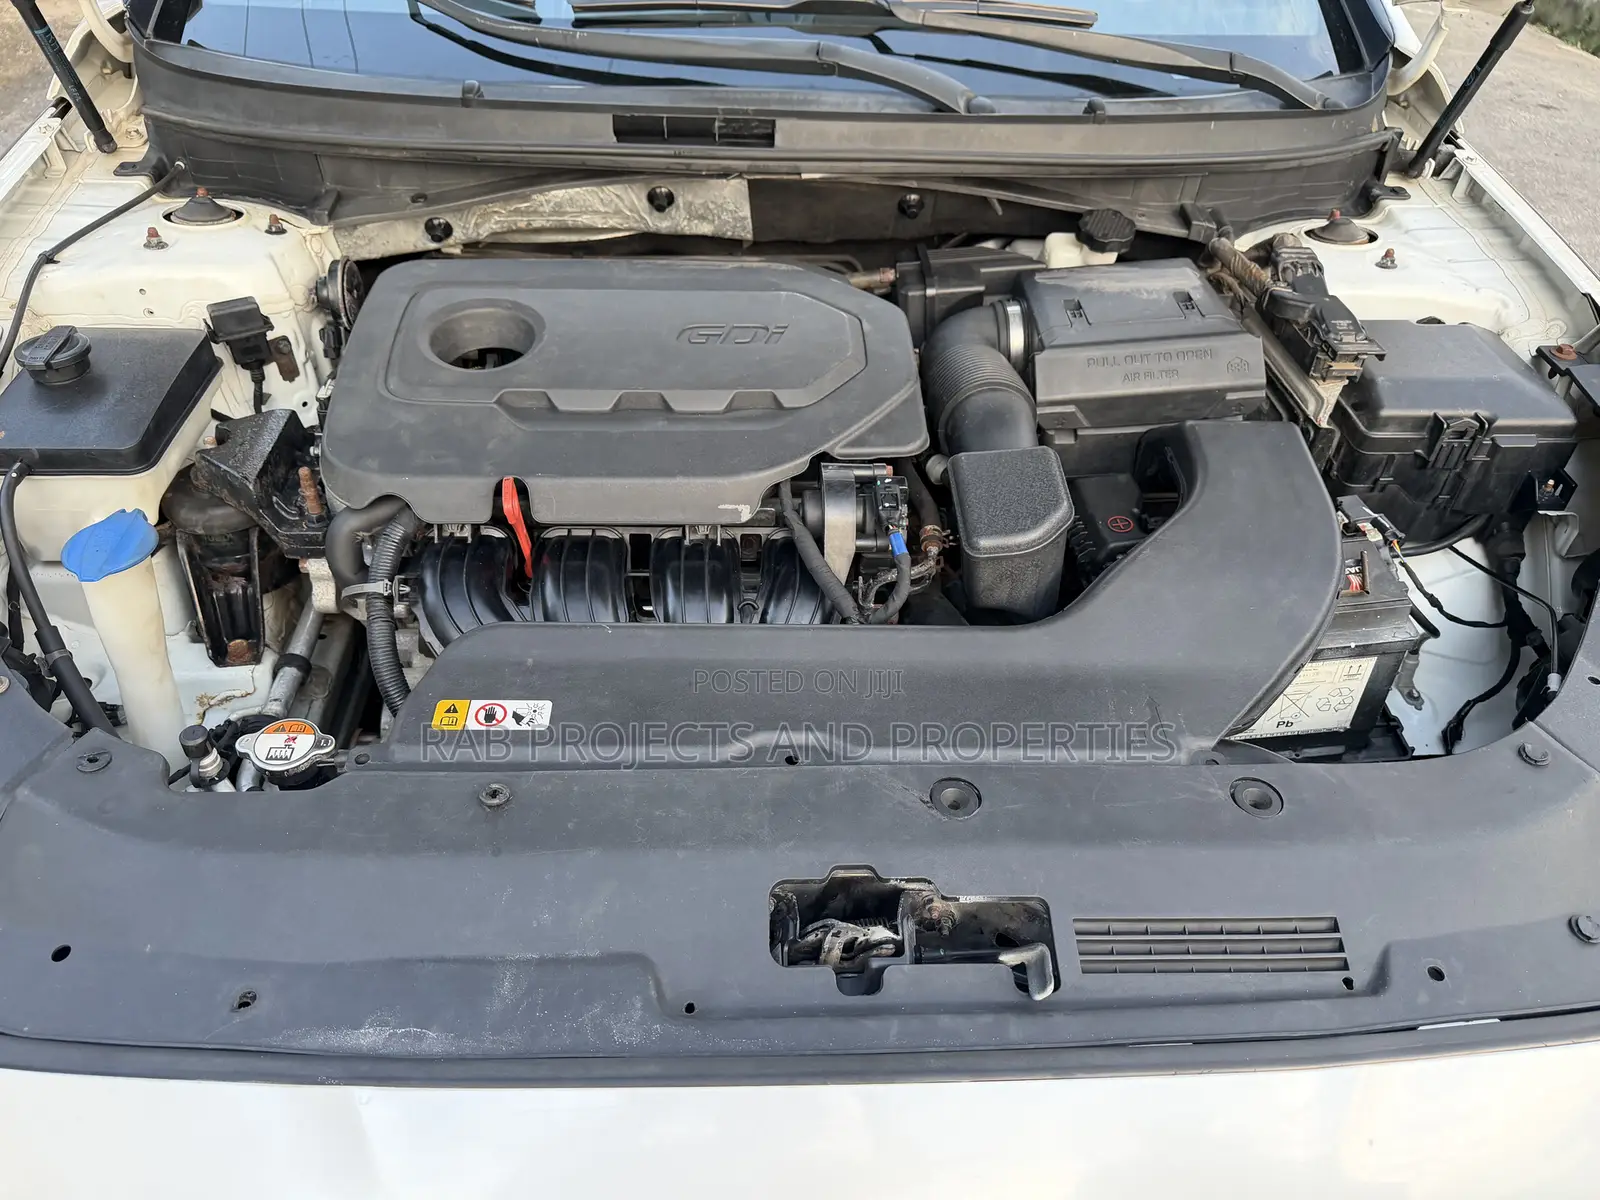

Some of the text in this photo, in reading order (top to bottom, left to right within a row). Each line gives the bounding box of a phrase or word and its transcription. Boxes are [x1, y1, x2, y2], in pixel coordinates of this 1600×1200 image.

[1086, 349, 1213, 368] PULL OUT TO OPEN
[1121, 369, 1179, 384] AIR FILTER
[1276, 720, 1294, 728] Pb
